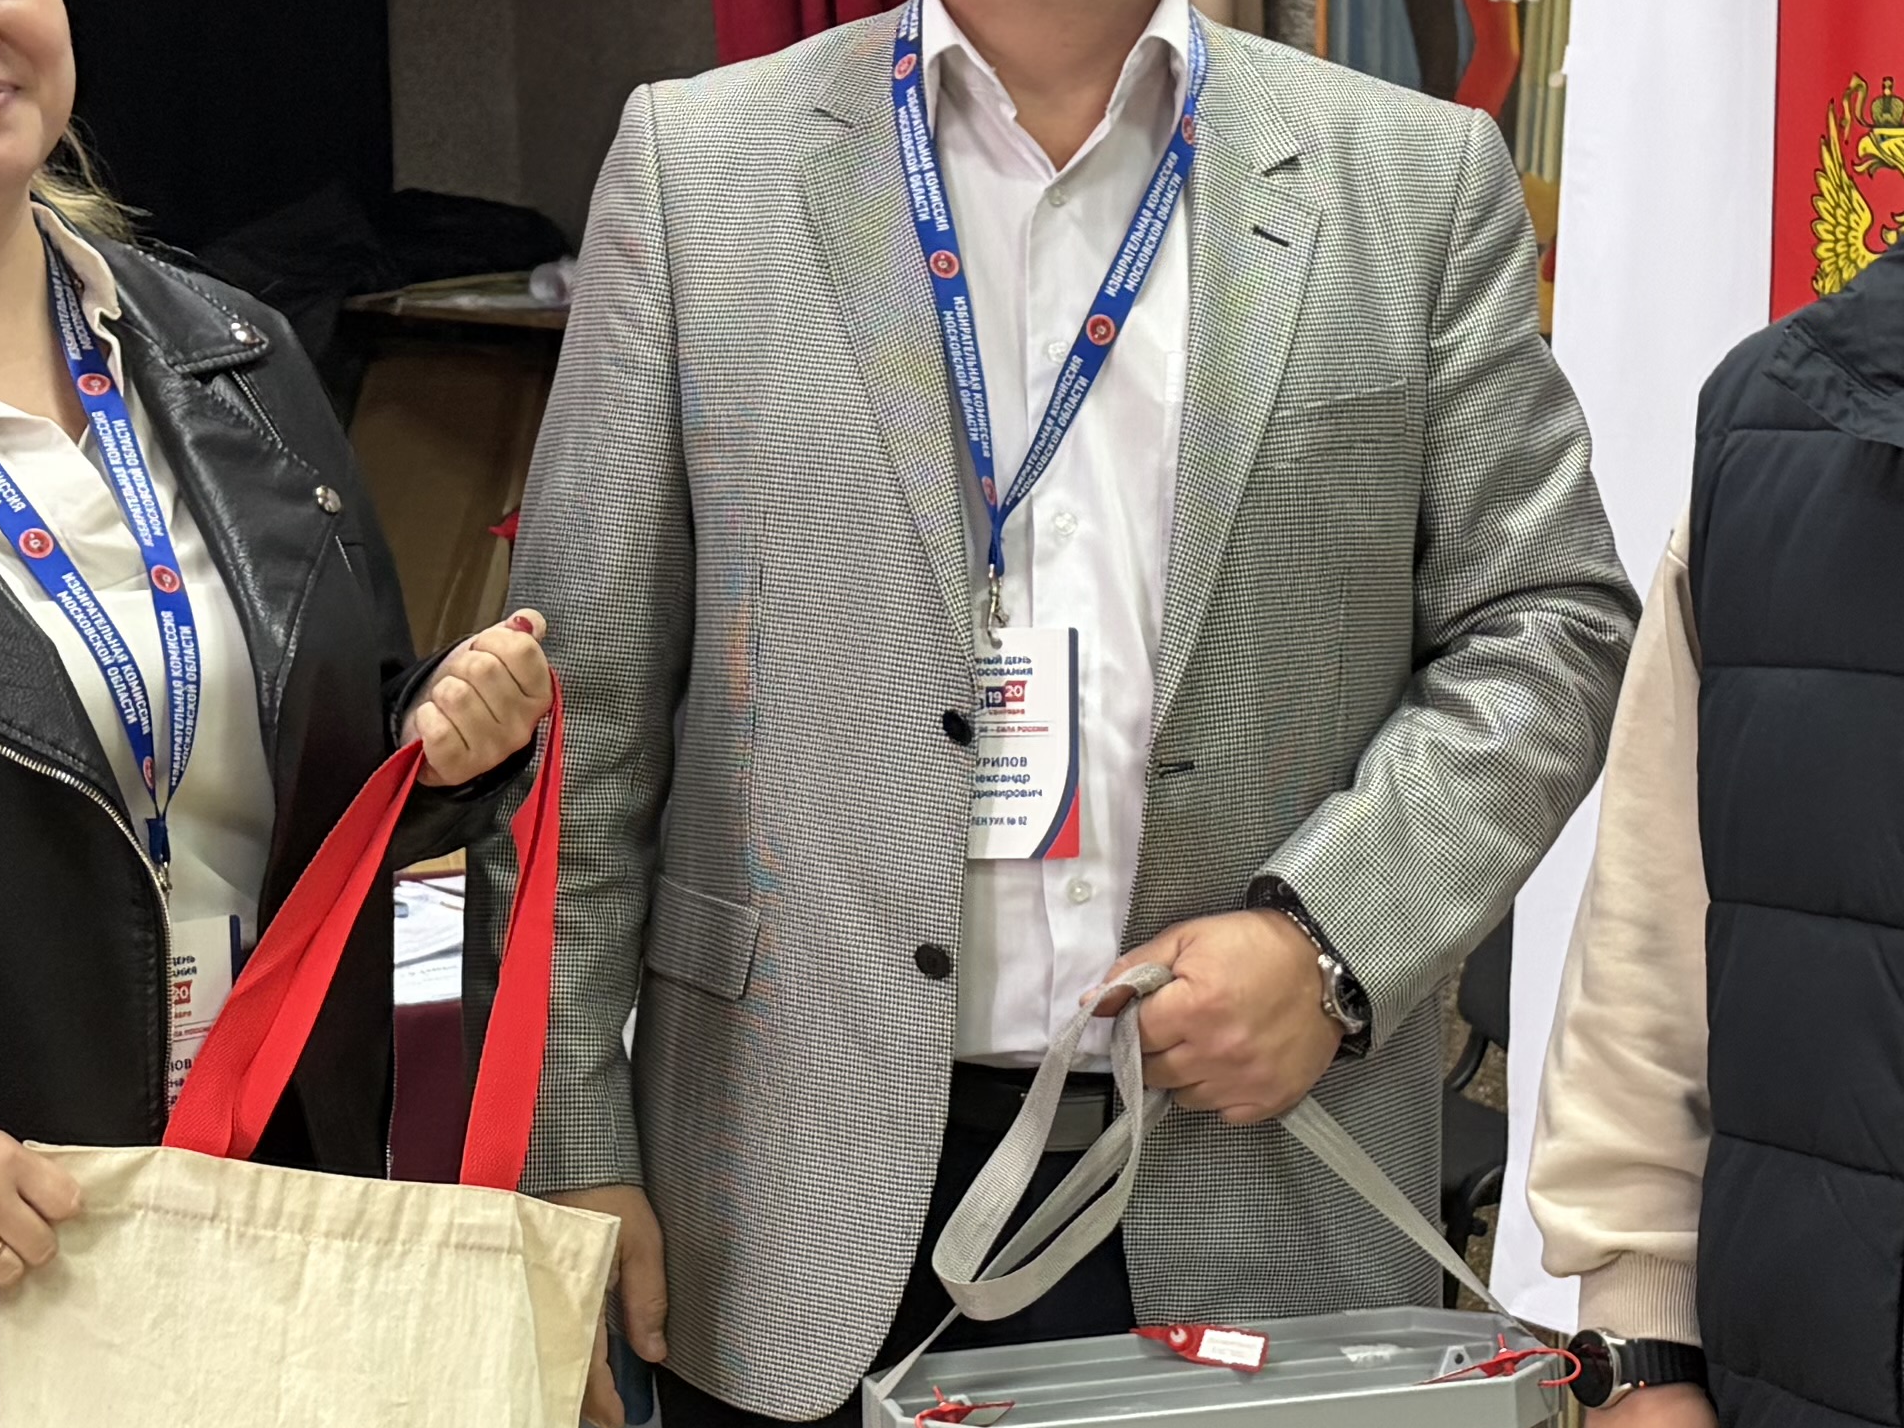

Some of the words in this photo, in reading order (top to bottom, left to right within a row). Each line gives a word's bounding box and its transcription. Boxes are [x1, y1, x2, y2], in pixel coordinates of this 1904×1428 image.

[898, 105, 923, 175] МОСКОВСКОЙ
[905, 85, 936, 171] ИЗБИРАТЕЛЬНАЯ
[923, 170, 950, 232] КОМИССИЯ
[909, 173, 931, 222] ОБЛАСТИ
[1104, 208, 1154, 298] ИЗБИРАТЕЛЬНАЯ
[1145, 151, 1179, 211] КОМИССИЯ
[1124, 218, 1165, 293] МОСКОВСКОЙ
[1156, 172, 1183, 222] ОБЛАСТИ
[943, 310, 972, 388] МОСКОВСКОЙ
[959, 389, 980, 442] ОБЛАСТИ
[953, 295, 983, 391] ИЗБИРАТЕЛЬНАЯ
[973, 392, 991, 459] КОМИССИЯ
[56, 590, 116, 666] МОСКОВСКОЙ
[107, 666, 138, 725] ОБЛАСТИ
[61, 571, 129, 664] ИЗБИРАТЕЛЬНАЯ
[120, 663, 152, 736] КОМИССИЯ
[988, 691, 1003, 704] 19
[1004, 684, 1024, 698] 20
